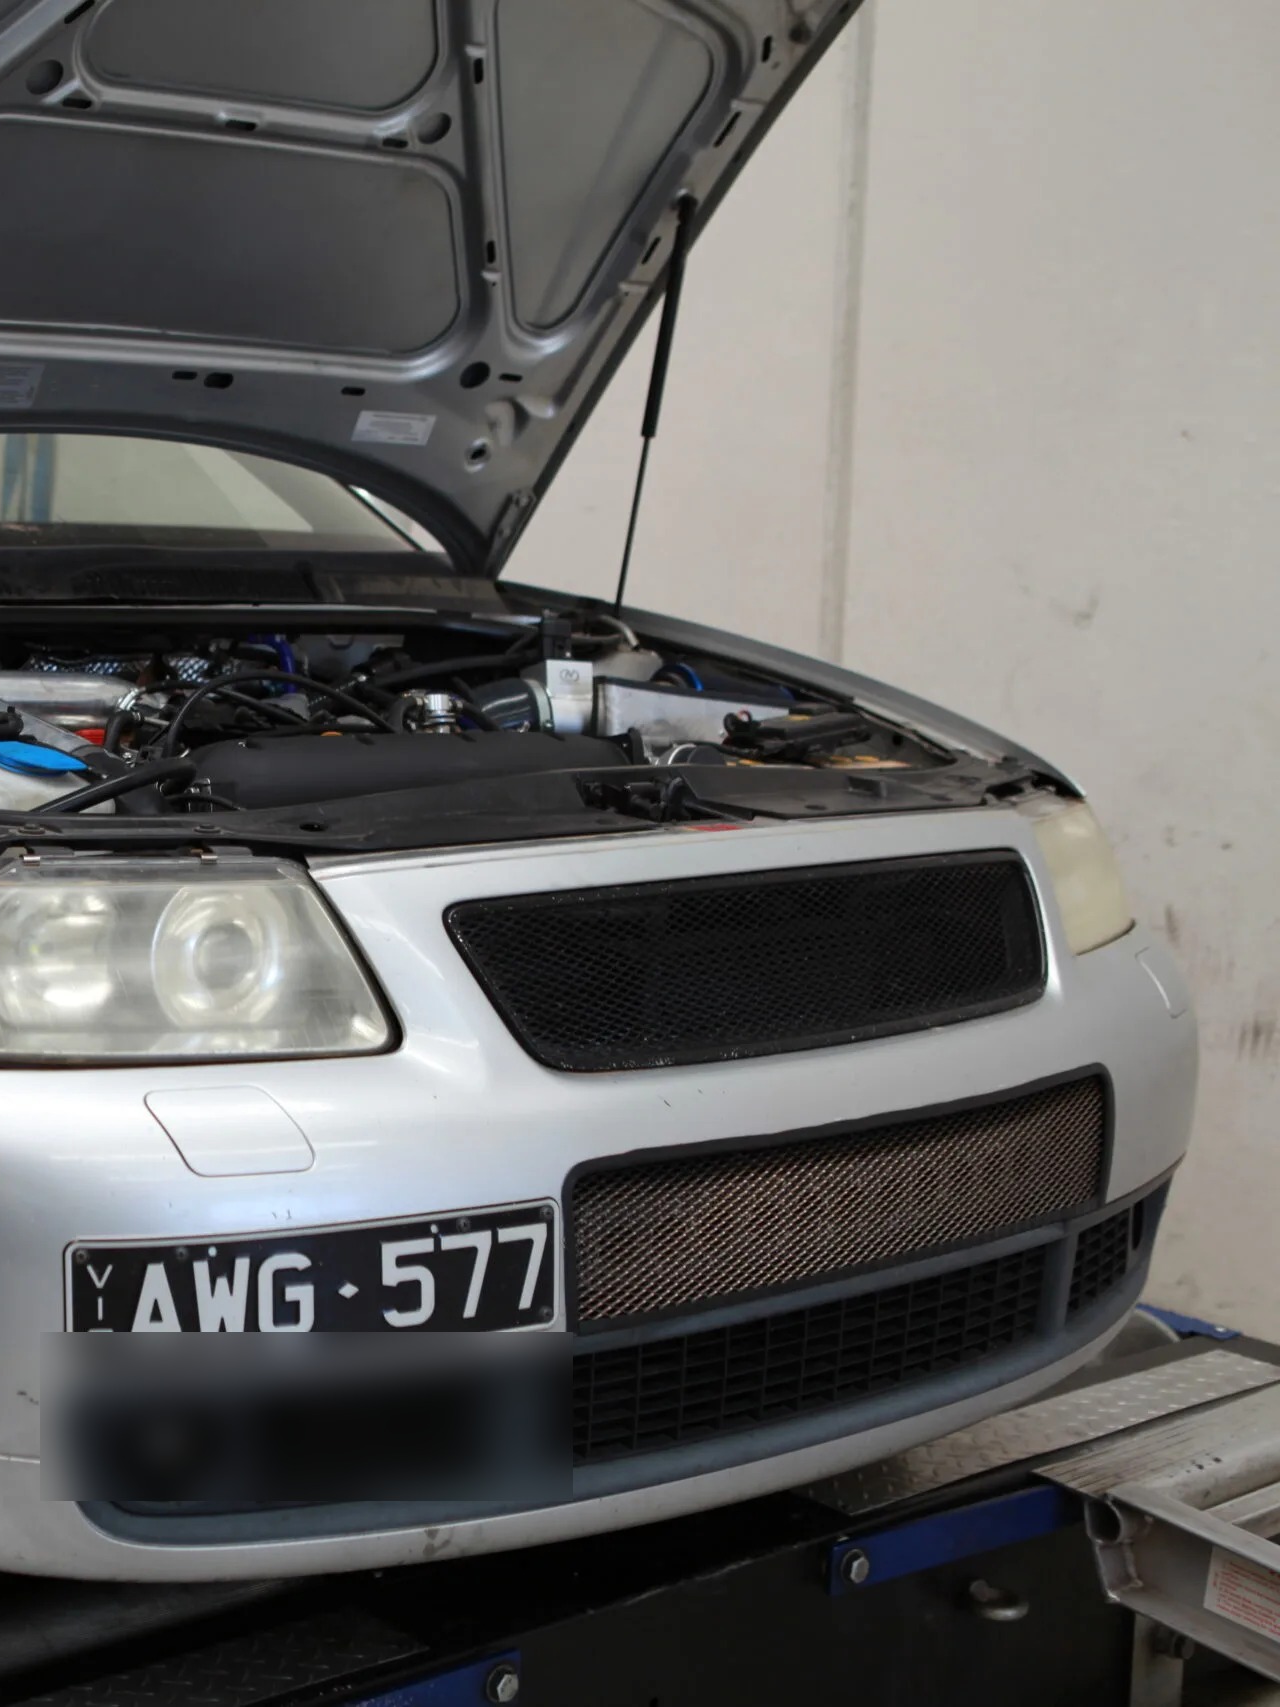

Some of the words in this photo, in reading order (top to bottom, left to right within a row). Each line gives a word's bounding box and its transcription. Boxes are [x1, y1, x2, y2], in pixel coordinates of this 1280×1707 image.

[86, 1263, 114, 1333] VI
[131, 1252, 315, 1333] AWG
[381, 1222, 548, 1329] 577
